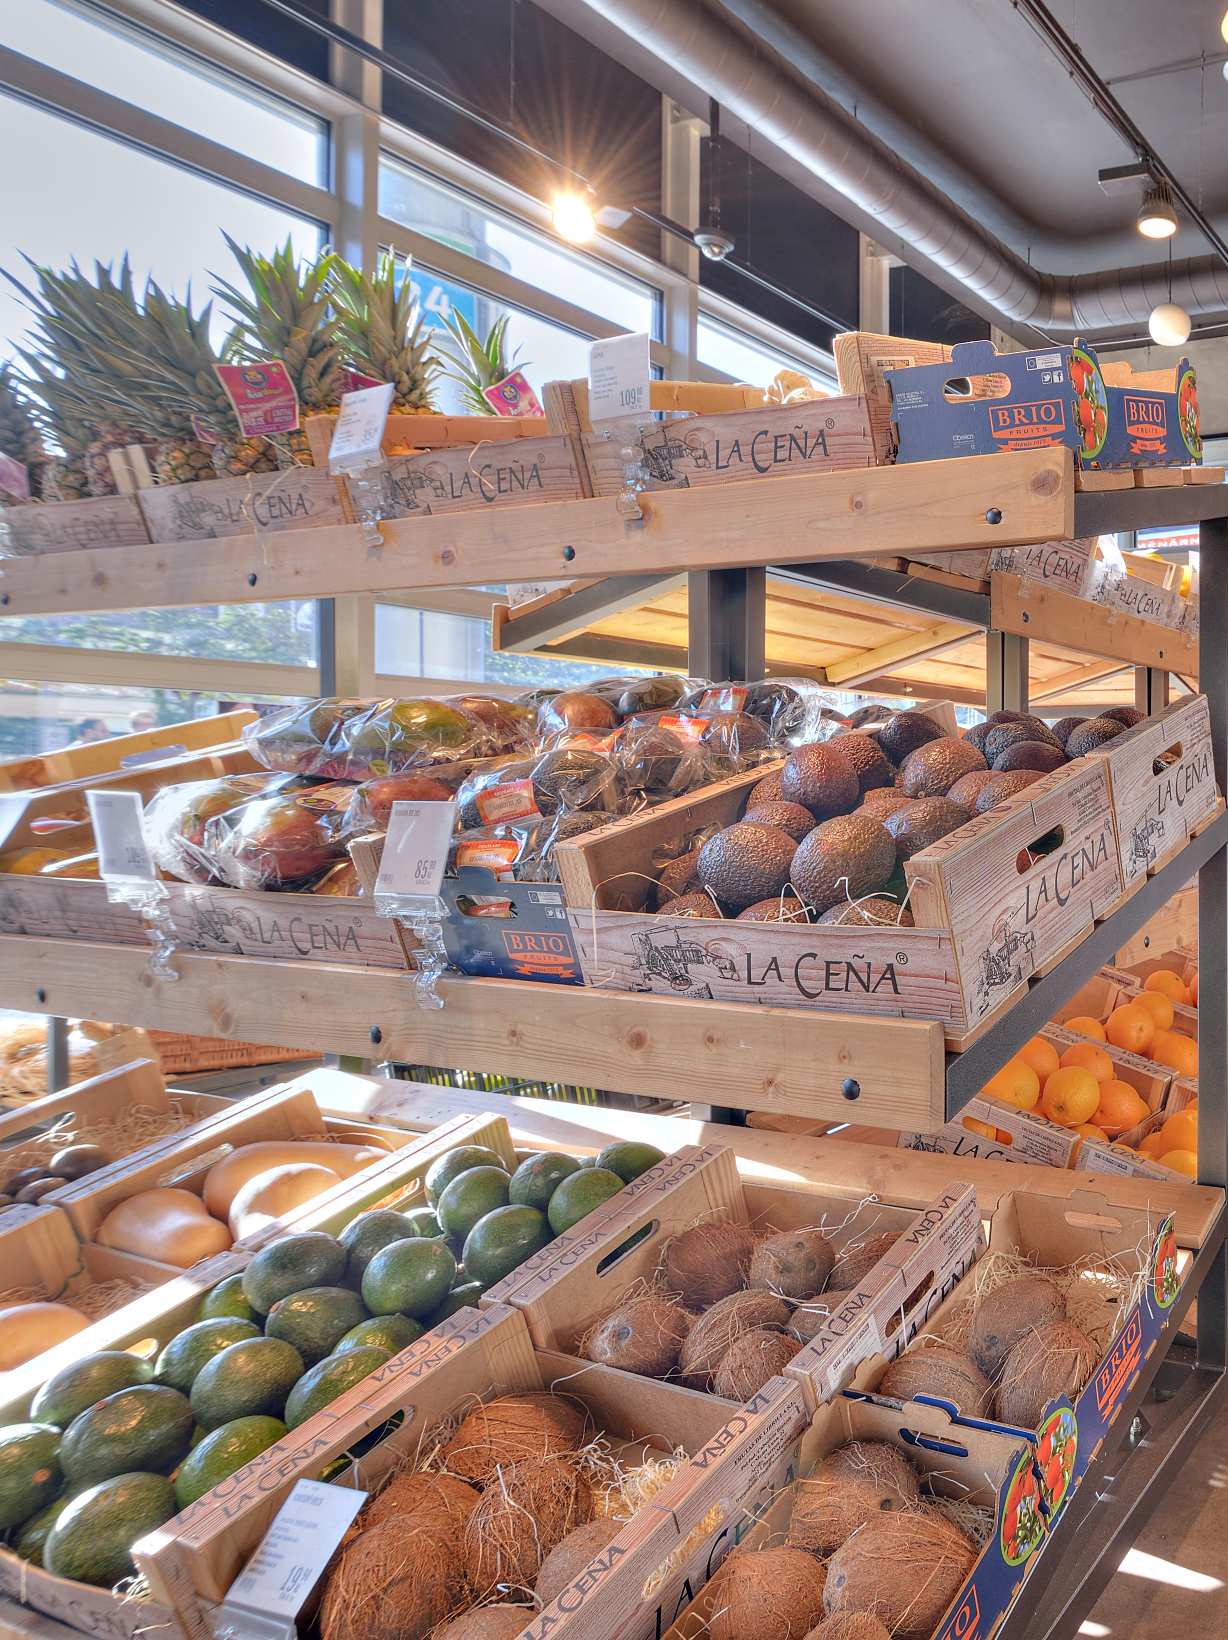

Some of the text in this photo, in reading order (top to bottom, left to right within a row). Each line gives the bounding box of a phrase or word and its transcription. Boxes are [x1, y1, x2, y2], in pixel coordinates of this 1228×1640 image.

[997, 403, 1056, 427] BRIO
[1129, 401, 1162, 423] BRIO
[715, 424, 830, 474] LA CEÑA
[449, 458, 544, 502] LA CEÑA
[1159, 778, 1173, 816] LA
[1175, 752, 1210, 807] CEÑA
[1024, 831, 1109, 925] LA CEÑA
[256, 915, 285, 944] LA
[510, 934, 564, 953] BRIO
[745, 952, 902, 999] LA CEÑA
[953, 1136, 981, 1160] LA
[905, 1194, 958, 1244] LA CEÑA
[810, 1335, 833, 1357] LA
[1101, 1322, 1137, 1392] BRIO
[689, 1392, 772, 1469] LA CEÑA
